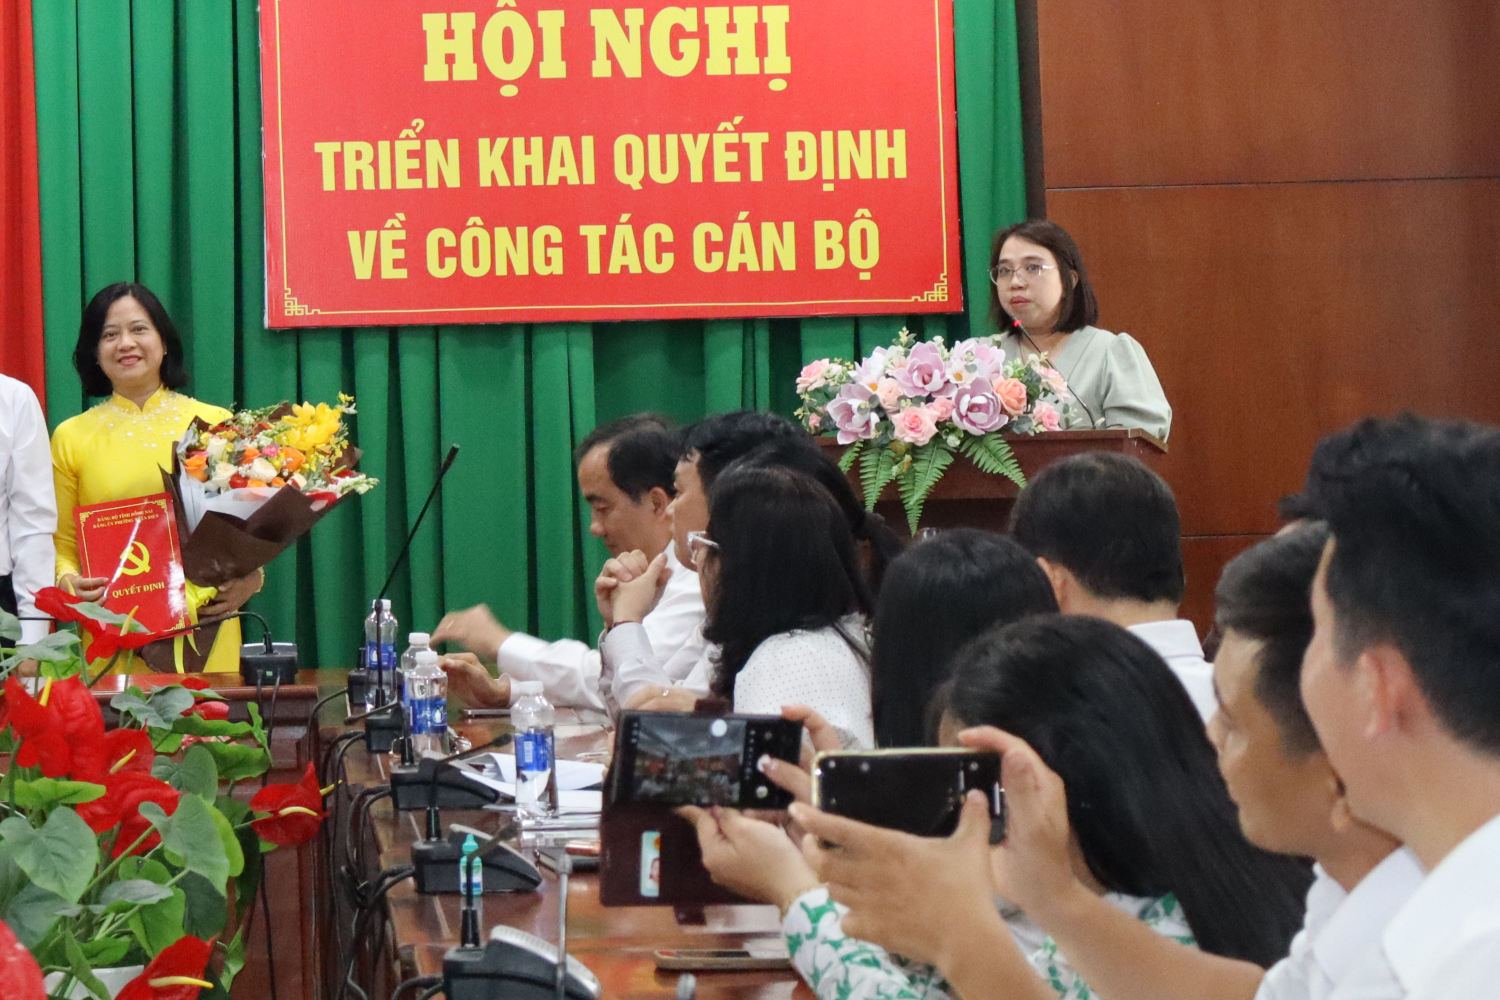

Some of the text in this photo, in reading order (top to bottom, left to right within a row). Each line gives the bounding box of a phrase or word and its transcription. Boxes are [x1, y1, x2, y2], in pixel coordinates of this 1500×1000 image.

[591, 5, 792, 92] NGHỊ
[314, 115, 907, 192] TRIỂN KHAI QUYẾT ĐỊNH
[348, 208, 880, 281] VỀ CÔNG TÁC CÁN BỘ
[112, 581, 165, 598] QUYẾT ĐỊNH
